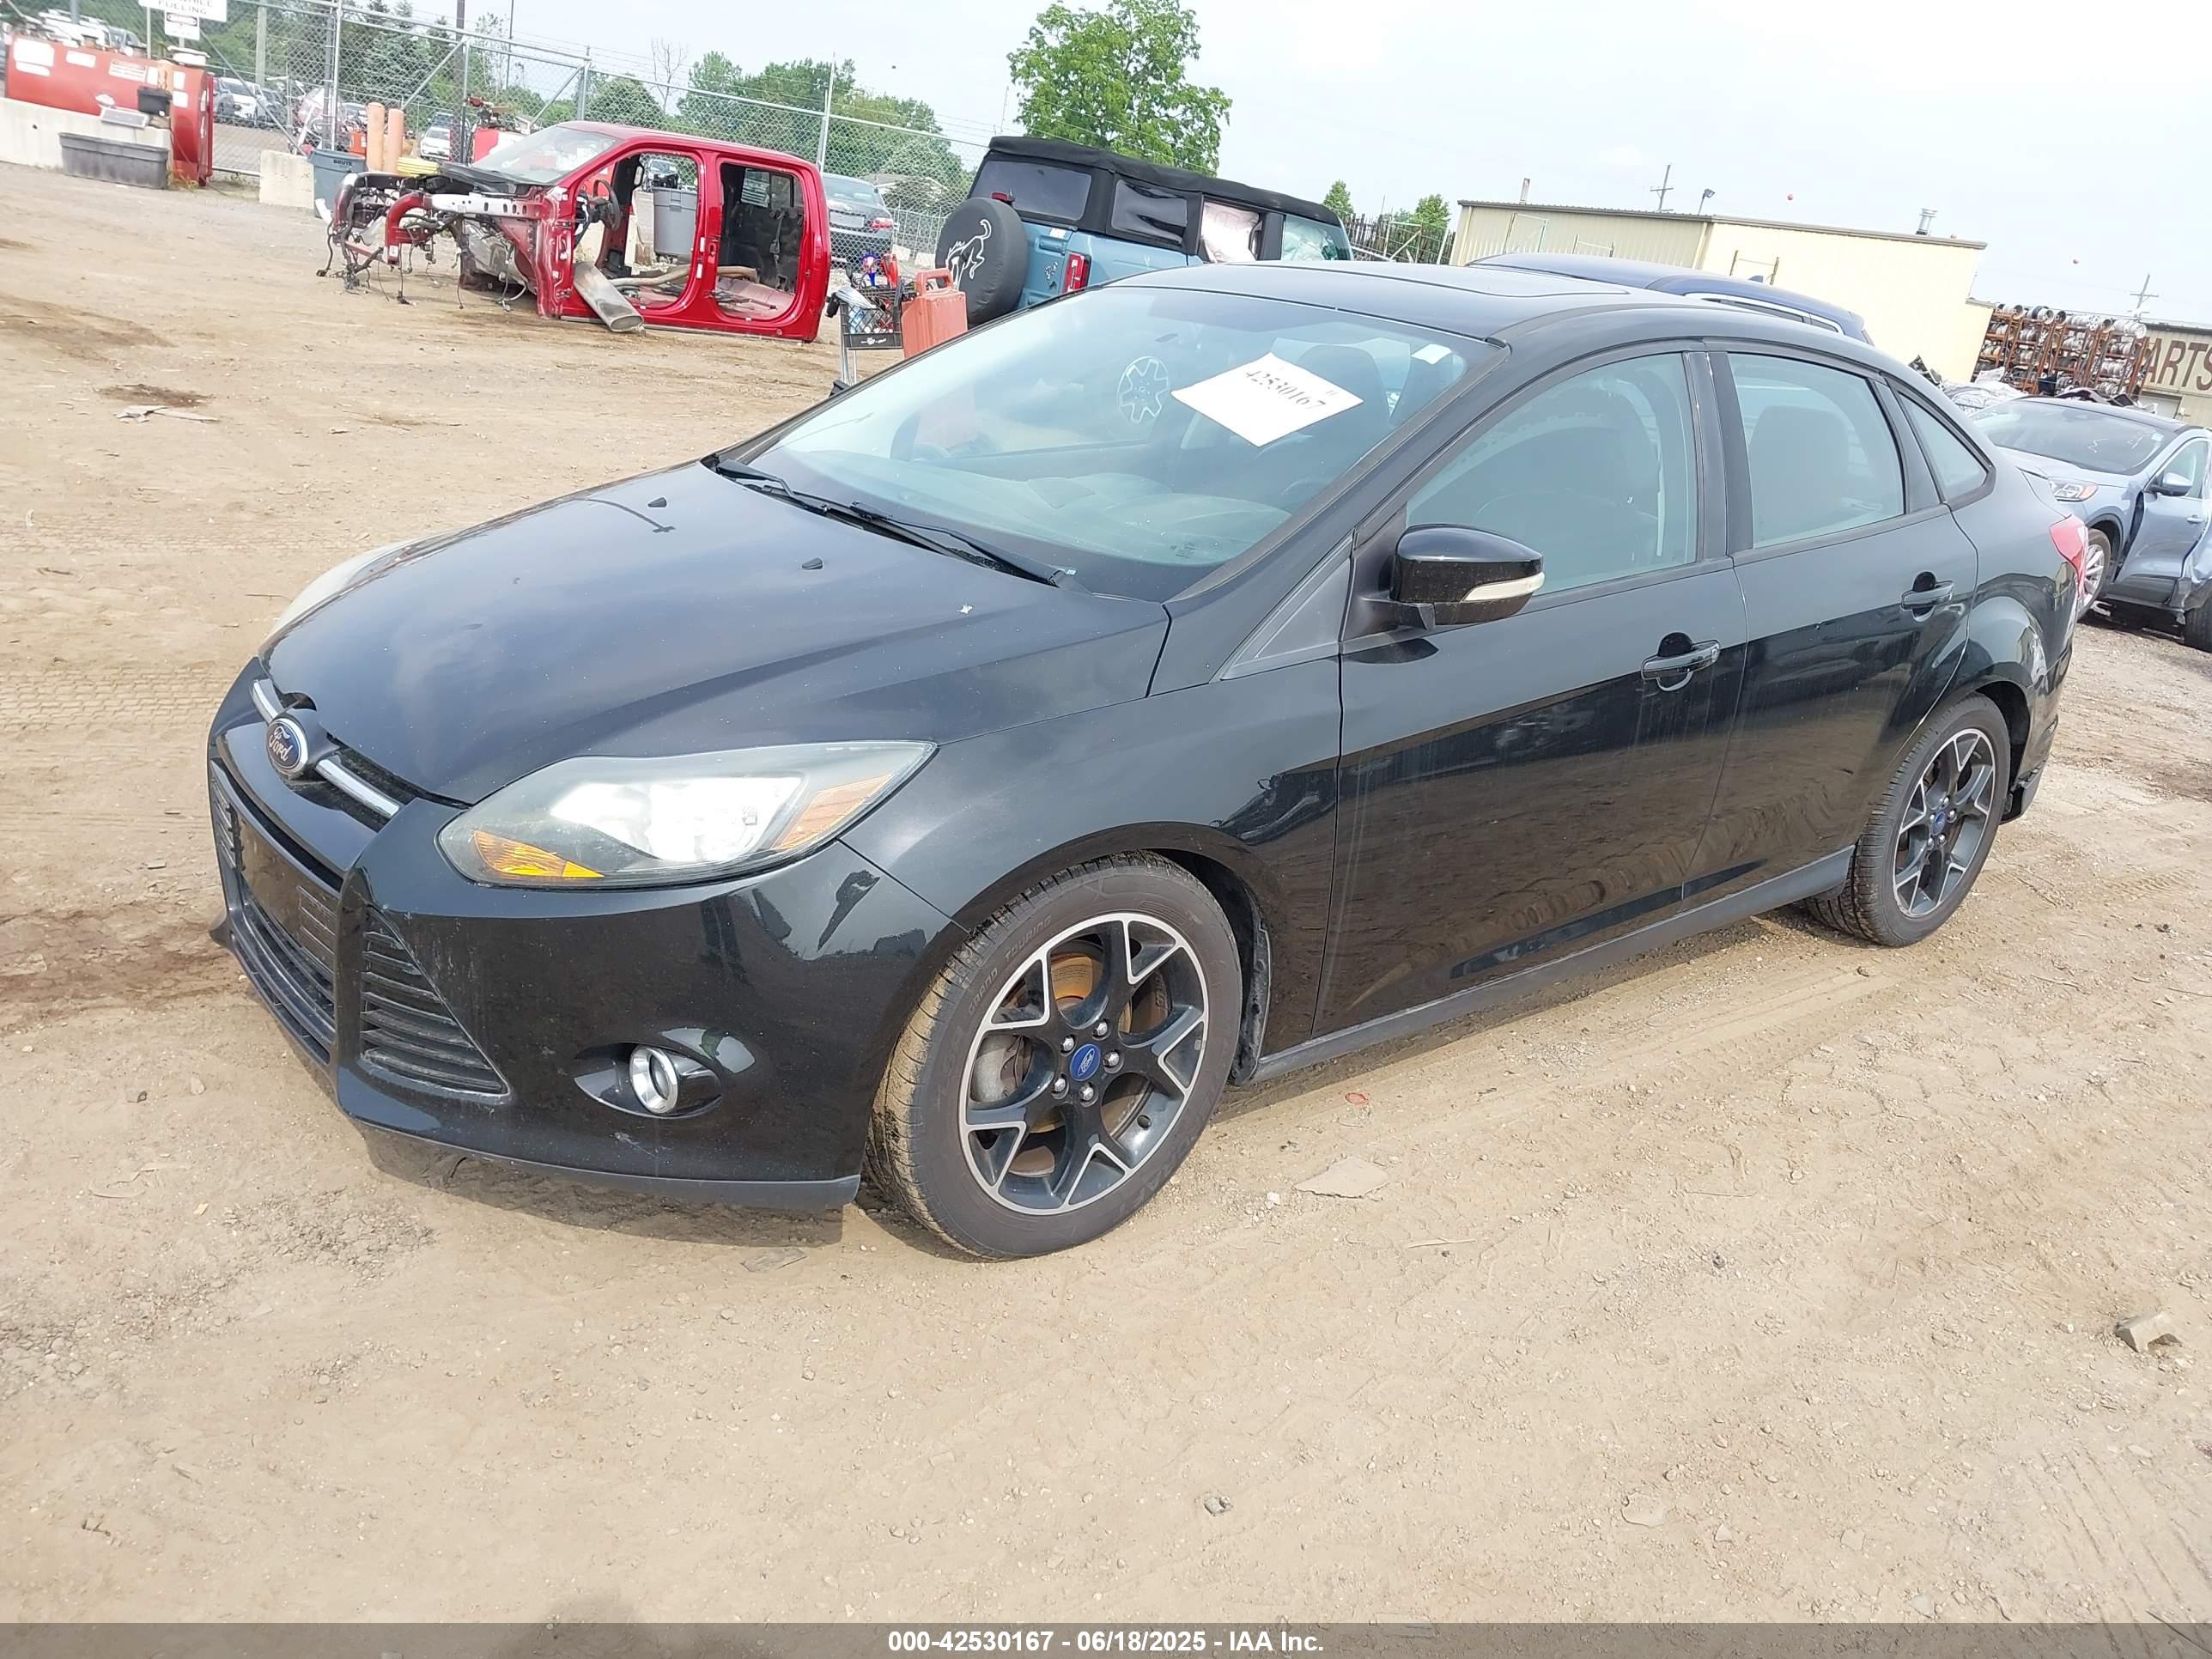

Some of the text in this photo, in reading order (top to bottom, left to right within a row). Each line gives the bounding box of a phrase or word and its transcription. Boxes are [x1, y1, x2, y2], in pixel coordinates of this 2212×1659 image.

[268, 726, 294, 762] Ford
[968, 967, 998, 1015] GRAND
[1005, 914, 1052, 963] TOURING
